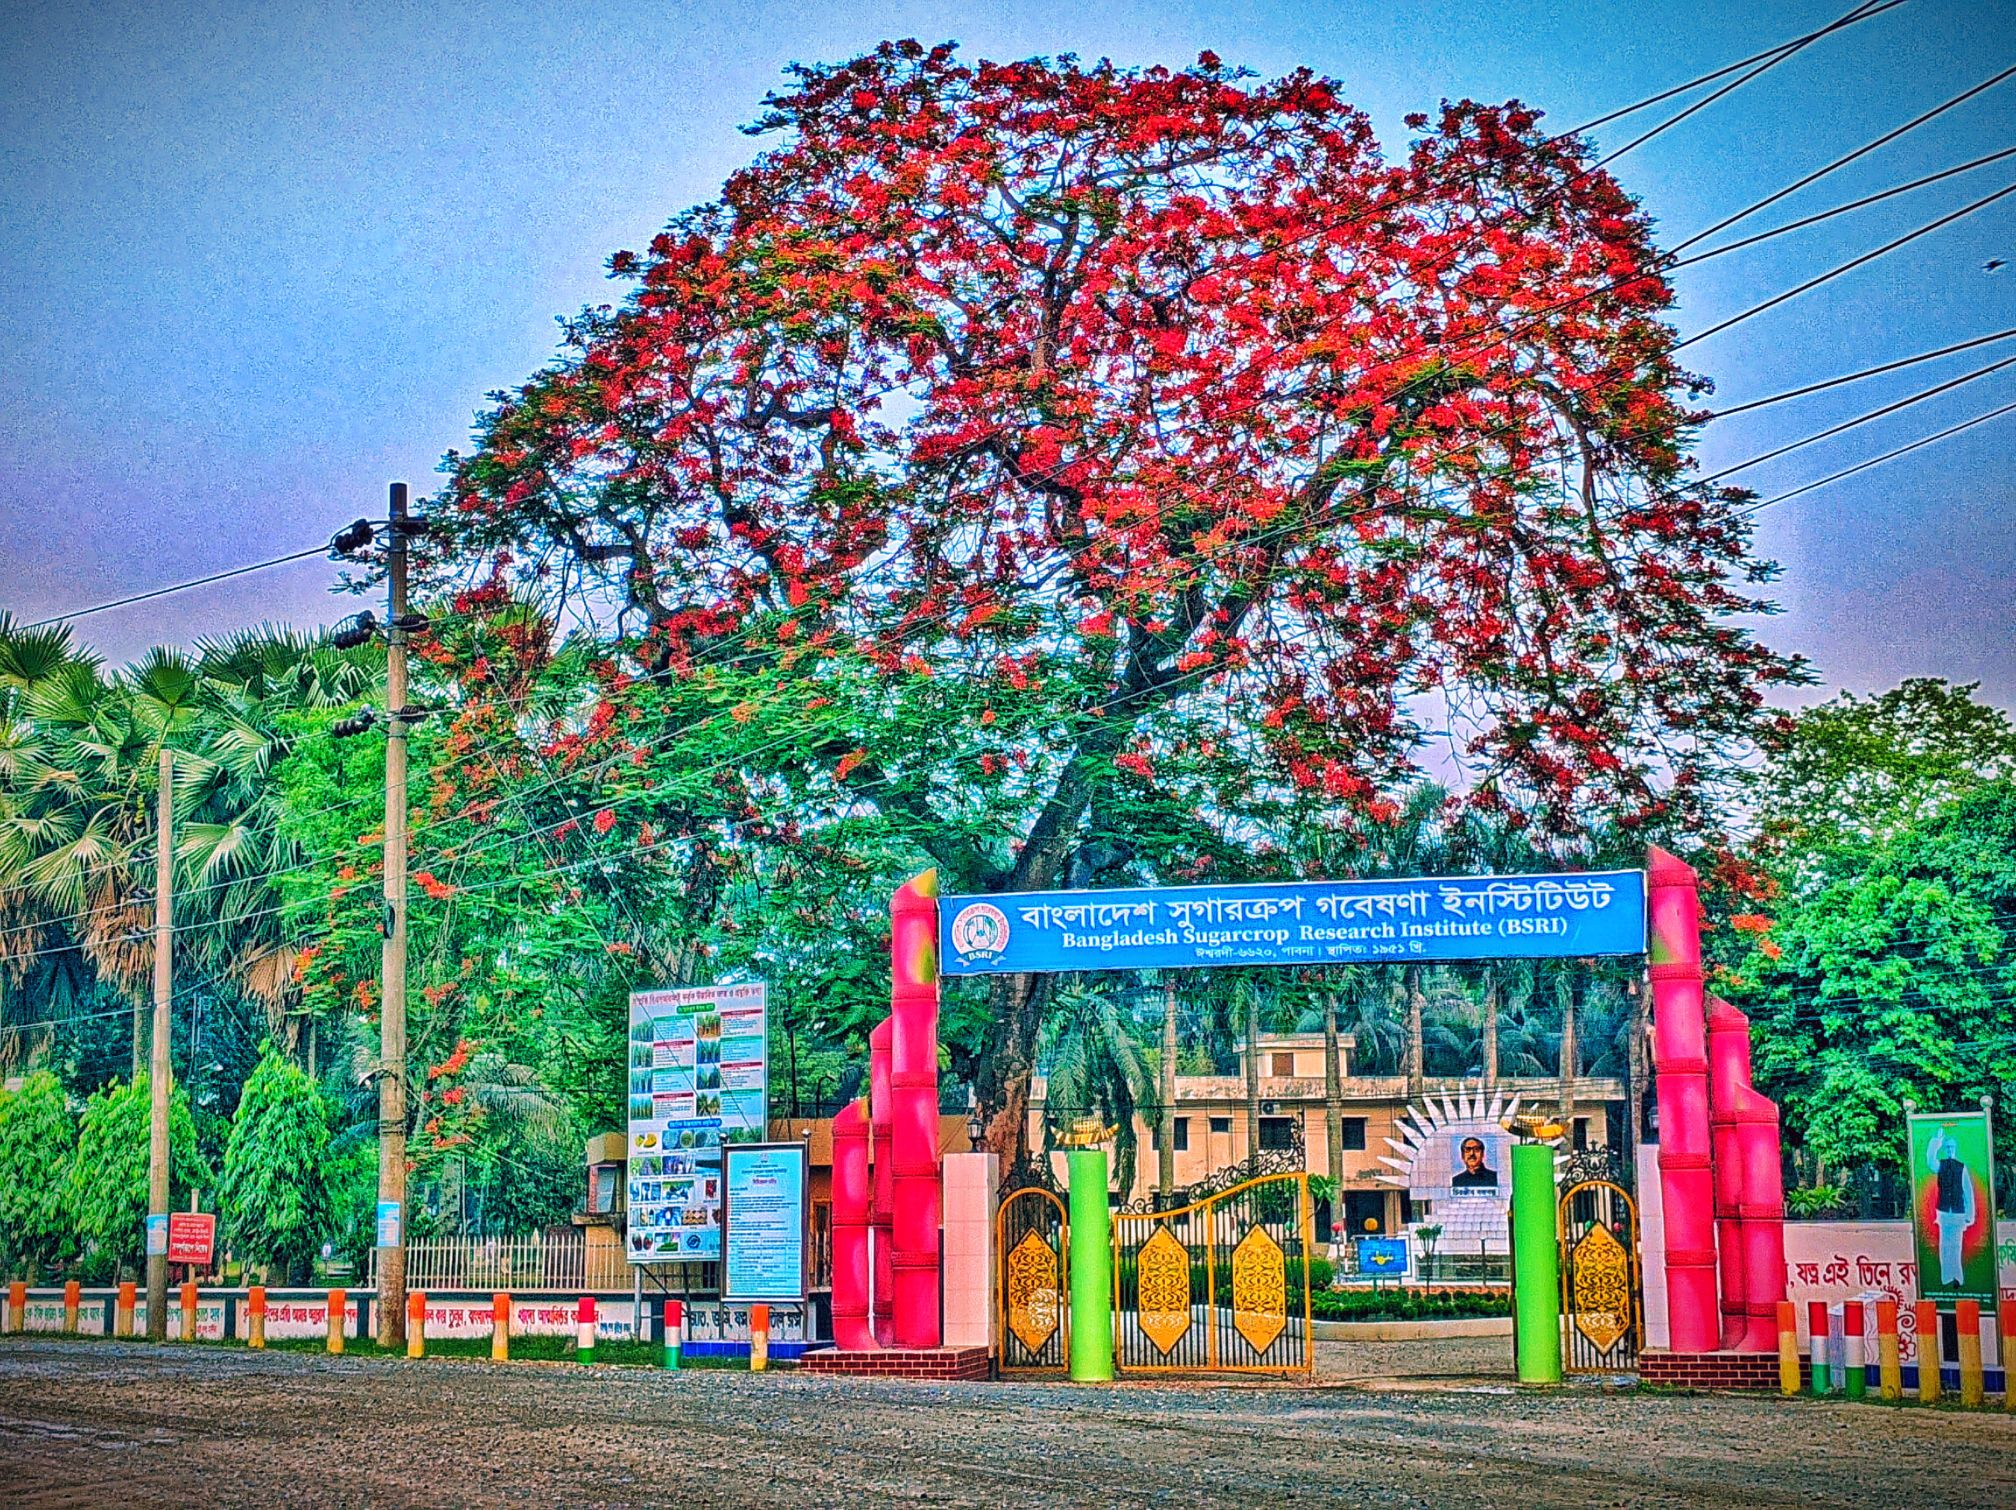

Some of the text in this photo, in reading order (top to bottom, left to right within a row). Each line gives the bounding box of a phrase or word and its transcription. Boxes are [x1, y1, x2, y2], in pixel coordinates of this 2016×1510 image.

[1017, 899, 1157, 930] বাংলাদেশ
[1168, 894, 1305, 932] সুগারক্রপ
[1316, 889, 1431, 921] গবেষণা
[1438, 879, 1615, 918] ইনস্টিটিউট
[1061, 917, 1568, 950] Bangladesh Sugarcrop Research Institute (BSRI)
[967, 951, 993, 961] BSRI
[1795, 1261, 1819, 1286] যত্ন
[1822, 1255, 1850, 1287] এই
[1856, 1255, 1892, 1287] তিনে
[1897, 1261, 1918, 1286] র
